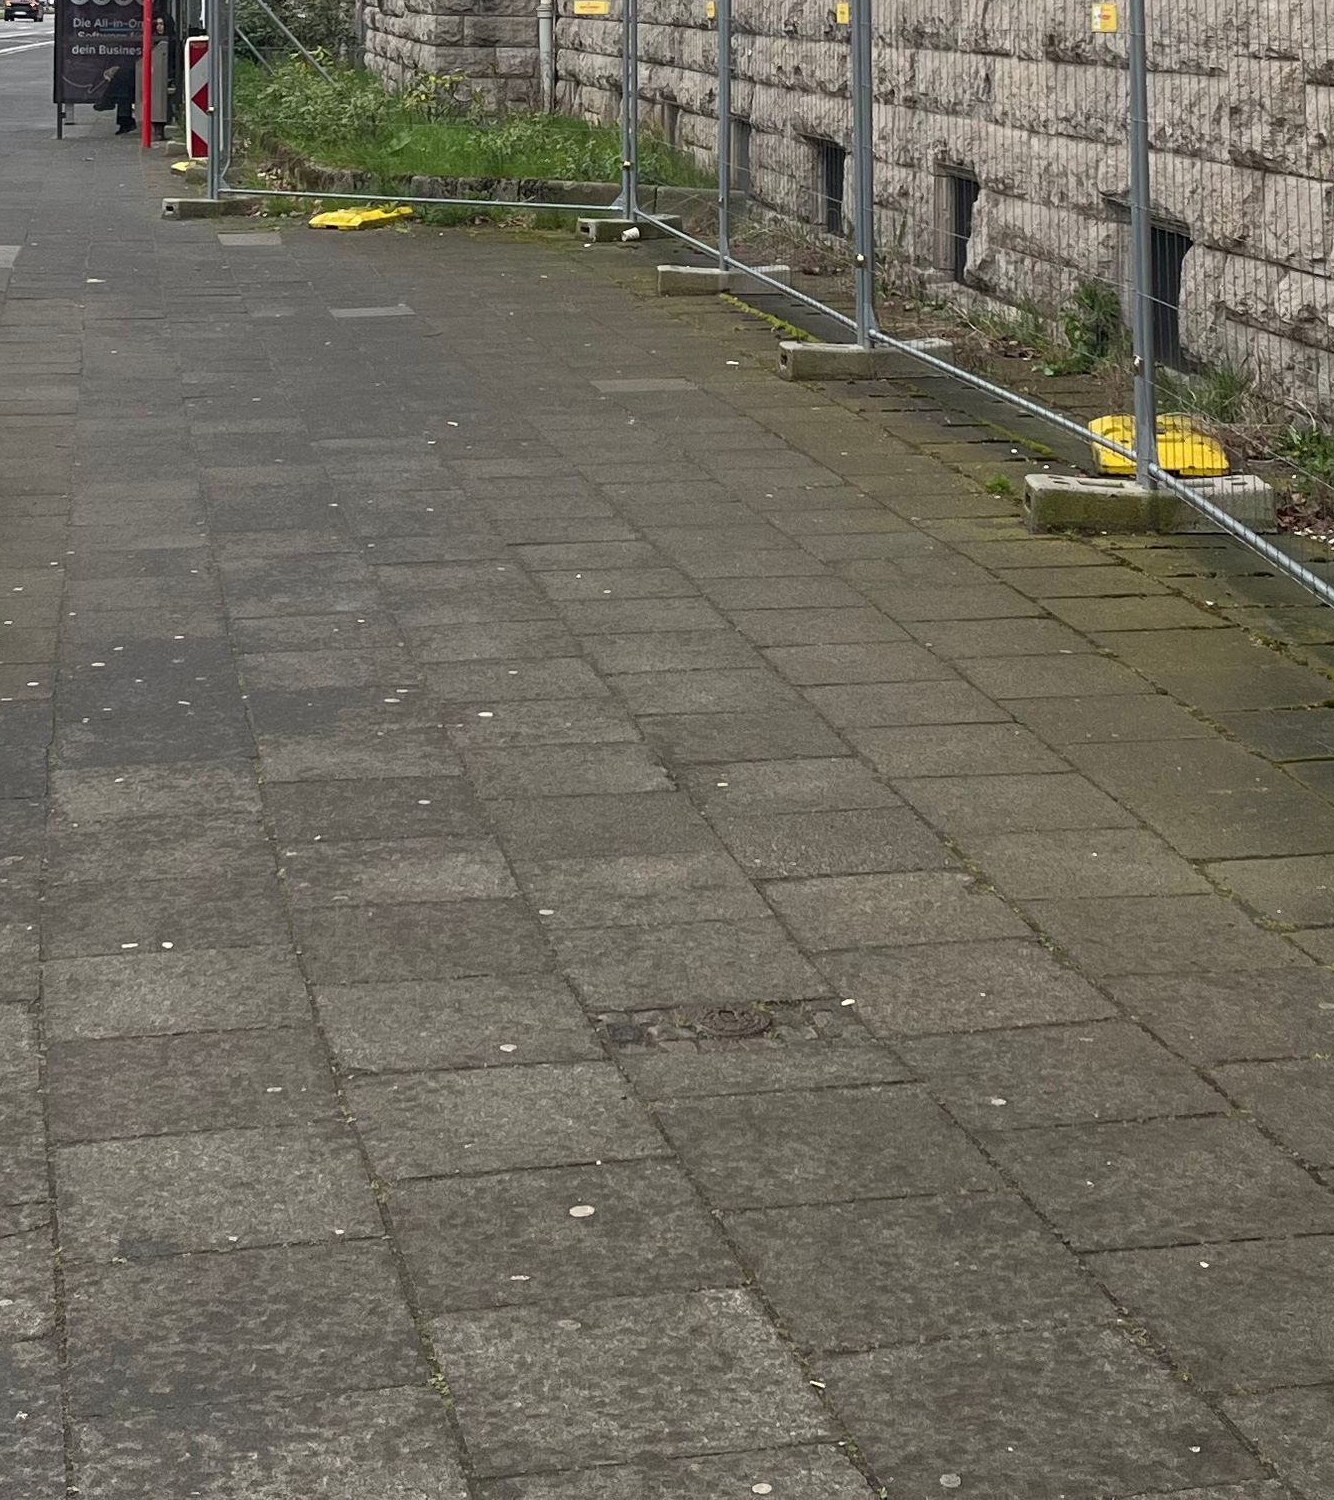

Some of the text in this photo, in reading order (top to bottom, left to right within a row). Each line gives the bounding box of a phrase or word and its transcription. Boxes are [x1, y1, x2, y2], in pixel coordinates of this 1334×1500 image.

[73, 17, 144, 28] Die All-in-On
[71, 45, 143, 55] dein Busines
